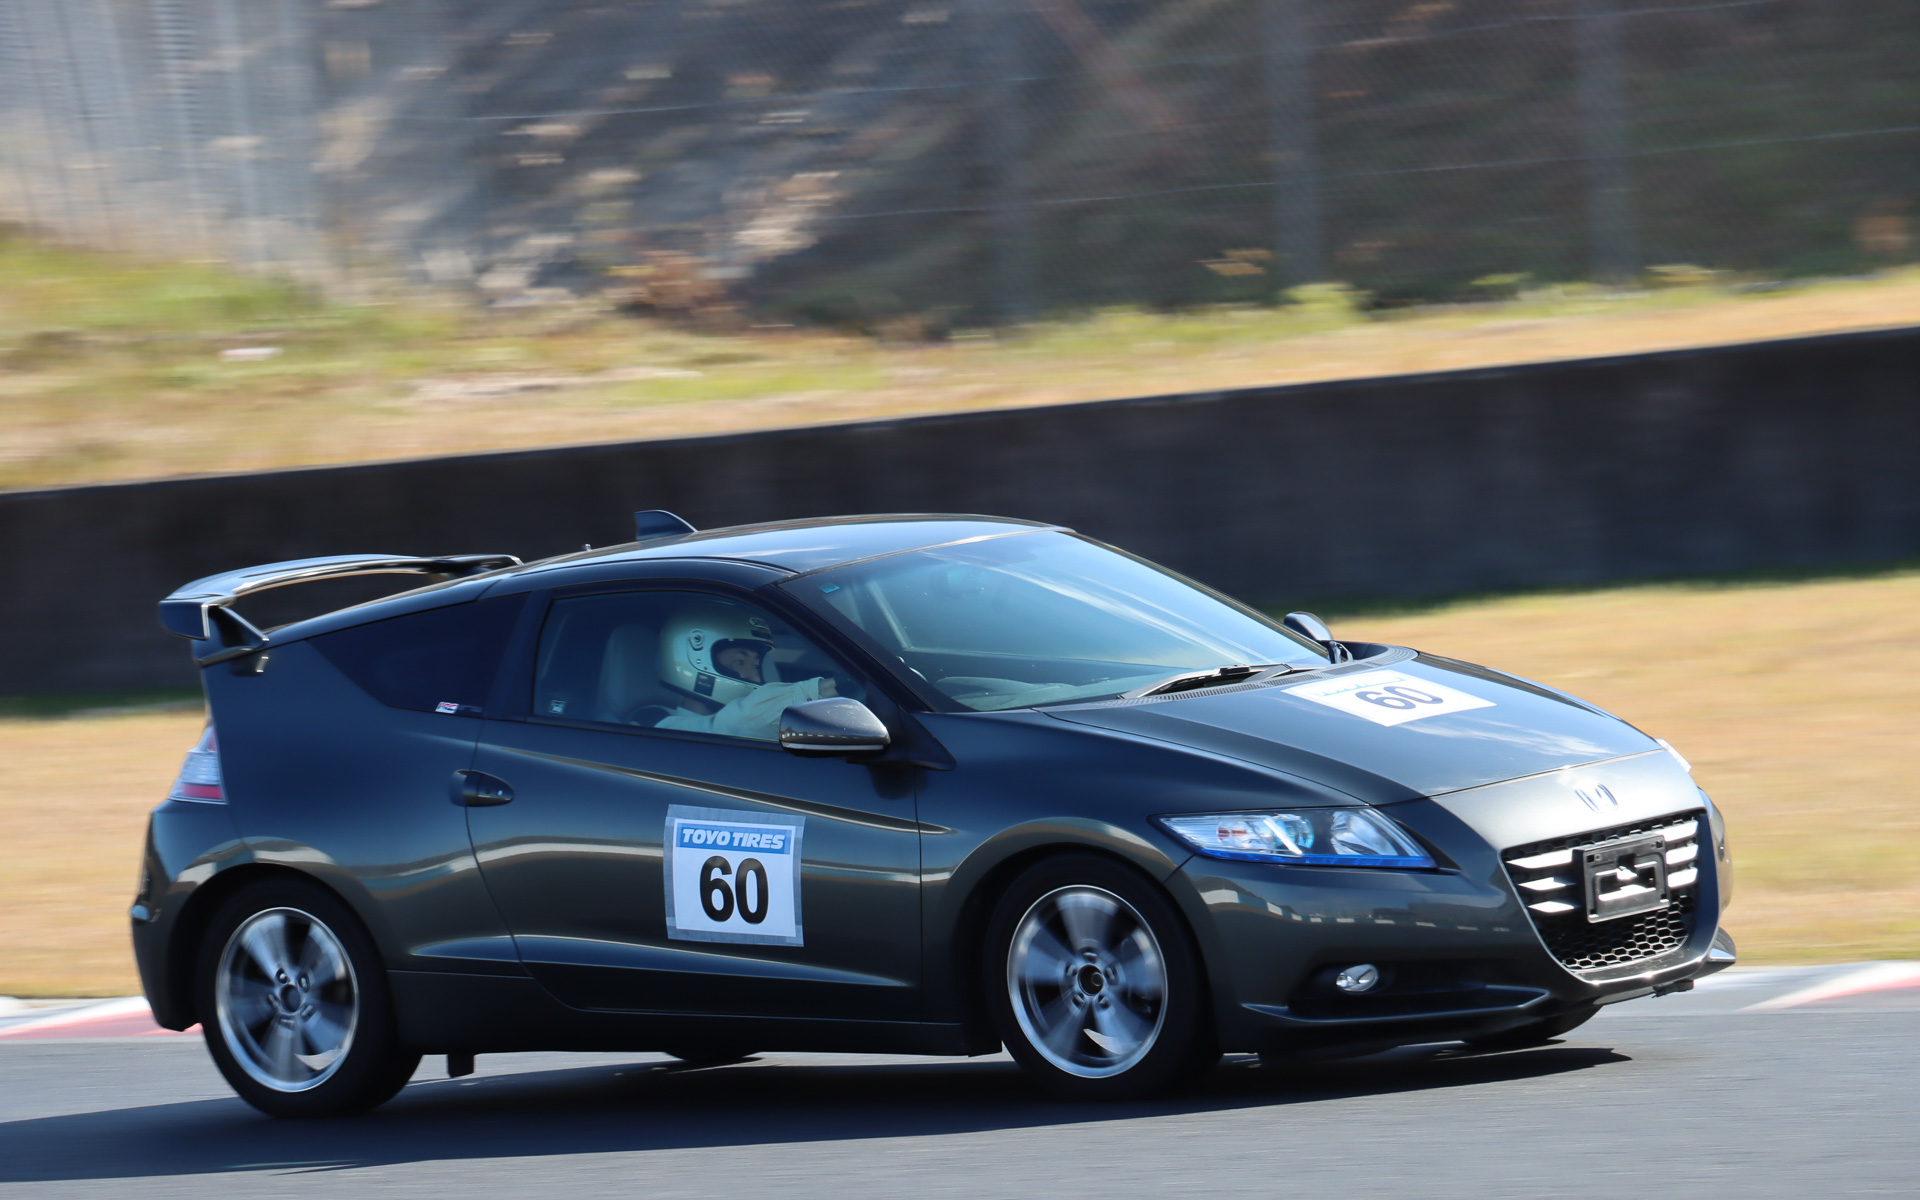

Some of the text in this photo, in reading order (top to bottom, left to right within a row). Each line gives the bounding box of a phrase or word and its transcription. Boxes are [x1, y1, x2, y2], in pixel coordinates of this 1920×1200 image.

[1355, 685, 1444, 710] 60
[682, 828, 786, 850] TOYO TIRES
[699, 855, 769, 925] 60
